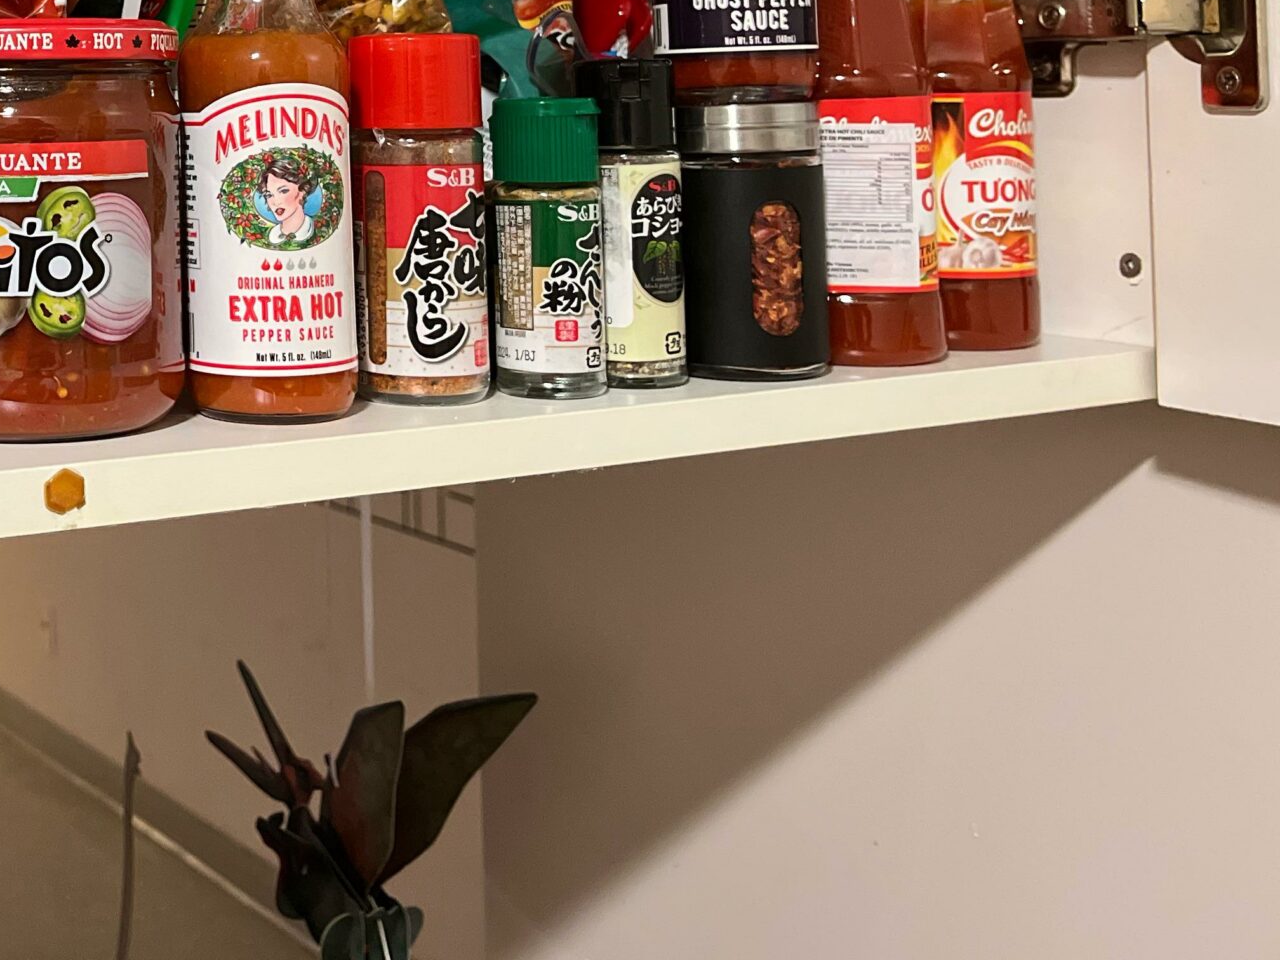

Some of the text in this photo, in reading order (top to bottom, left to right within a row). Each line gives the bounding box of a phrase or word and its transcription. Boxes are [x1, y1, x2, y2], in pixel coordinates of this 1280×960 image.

[730, 9, 790, 31] SAUCE
[93, 33, 124, 50] HOT
[214, 106, 345, 165] MELINDA'S
[427, 167, 475, 187] S&B
[557, 203, 600, 222] S&B
[237, 274, 335, 290] ORIGINAL HABANERO
[229, 291, 343, 323] EXTRA HOT
[242, 326, 334, 342] PEPPER SAUCE
[256, 352, 268, 362] Net
[281, 352, 287, 362] 5
